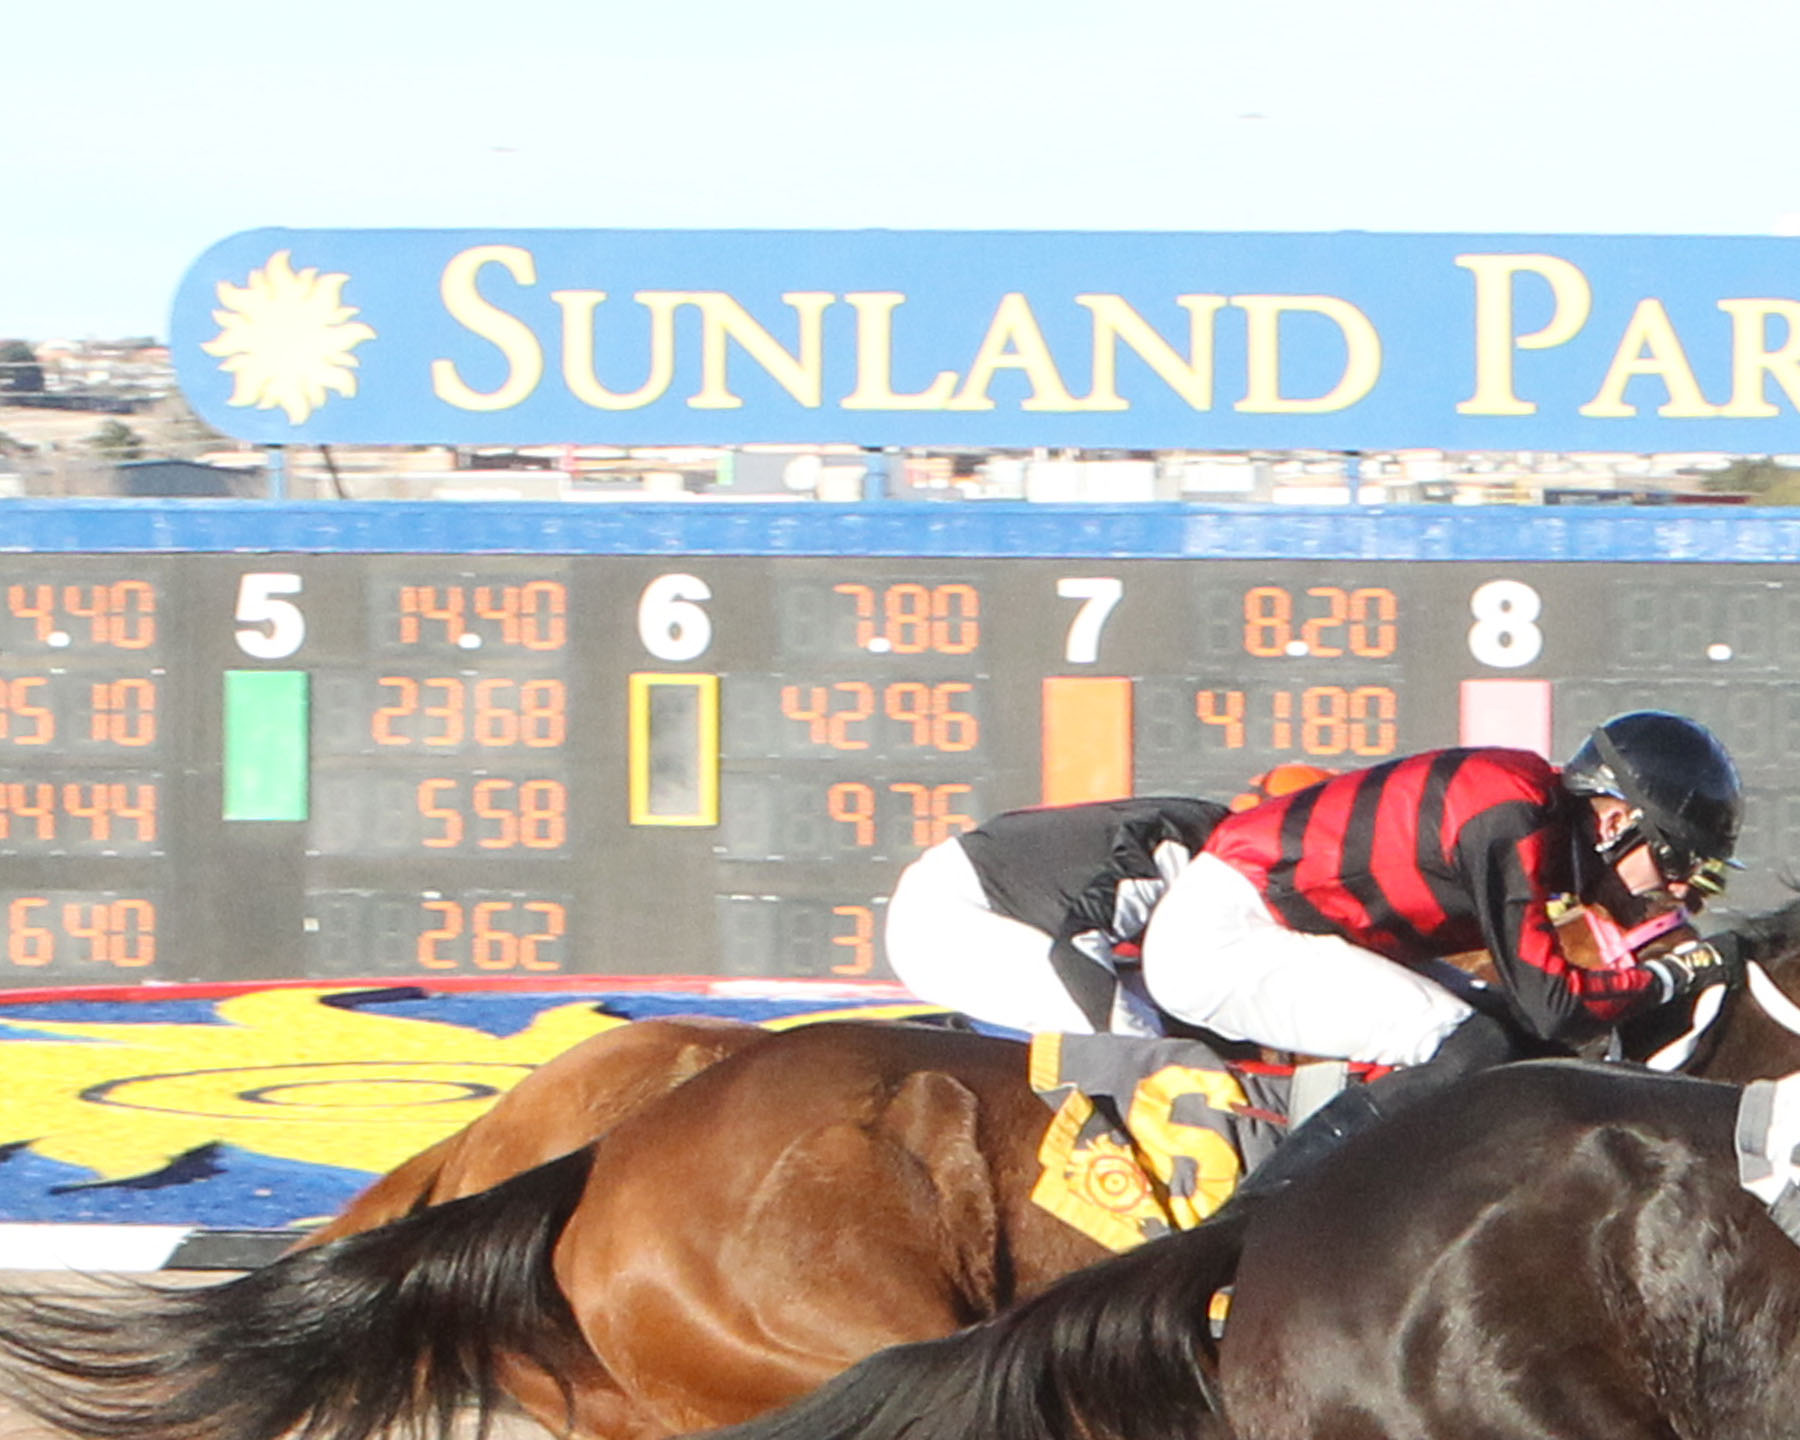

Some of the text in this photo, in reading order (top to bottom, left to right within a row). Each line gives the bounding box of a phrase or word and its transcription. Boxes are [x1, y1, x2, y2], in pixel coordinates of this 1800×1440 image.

[431, 244, 1382, 413] SUNLAND
[235, 573, 305, 659] 5
[400, 581, 567, 650] 14.40
[638, 574, 712, 661] 6
[834, 584, 980, 654] 7.80
[1057, 577, 1123, 663] 7
[1243, 587, 1398, 658] 8.20
[1468, 580, 1542, 668] 8
[0, 678, 156, 746] 510
[372, 676, 567, 747] 2368
[781, 682, 979, 752] 4296
[1195, 686, 1398, 756] 4180
[0, 782, 156, 841] 444
[418, 778, 568, 849] 558
[827, 782, 977, 847] 976
[8, 898, 157, 967] 640
[416, 901, 566, 971] 262
